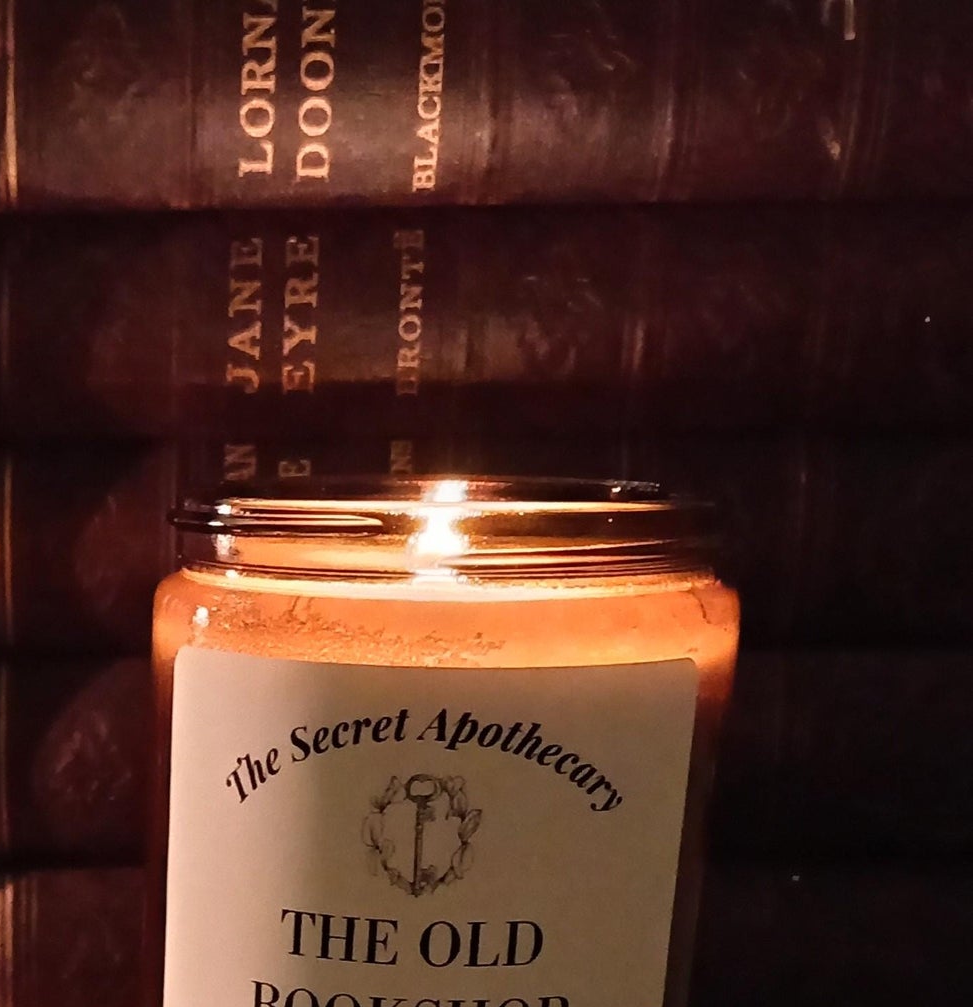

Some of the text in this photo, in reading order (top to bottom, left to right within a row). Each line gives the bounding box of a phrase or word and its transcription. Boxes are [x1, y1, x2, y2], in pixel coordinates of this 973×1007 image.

[238, 0, 277, 177] LORN
[412, 0, 445, 192] BLACKMO
[227, 236, 262, 394] JANE
[282, 235, 319, 393] EYRE
[226, 708, 624, 813] The Secret Apothecary
[281, 908, 543, 968] THE OLD
